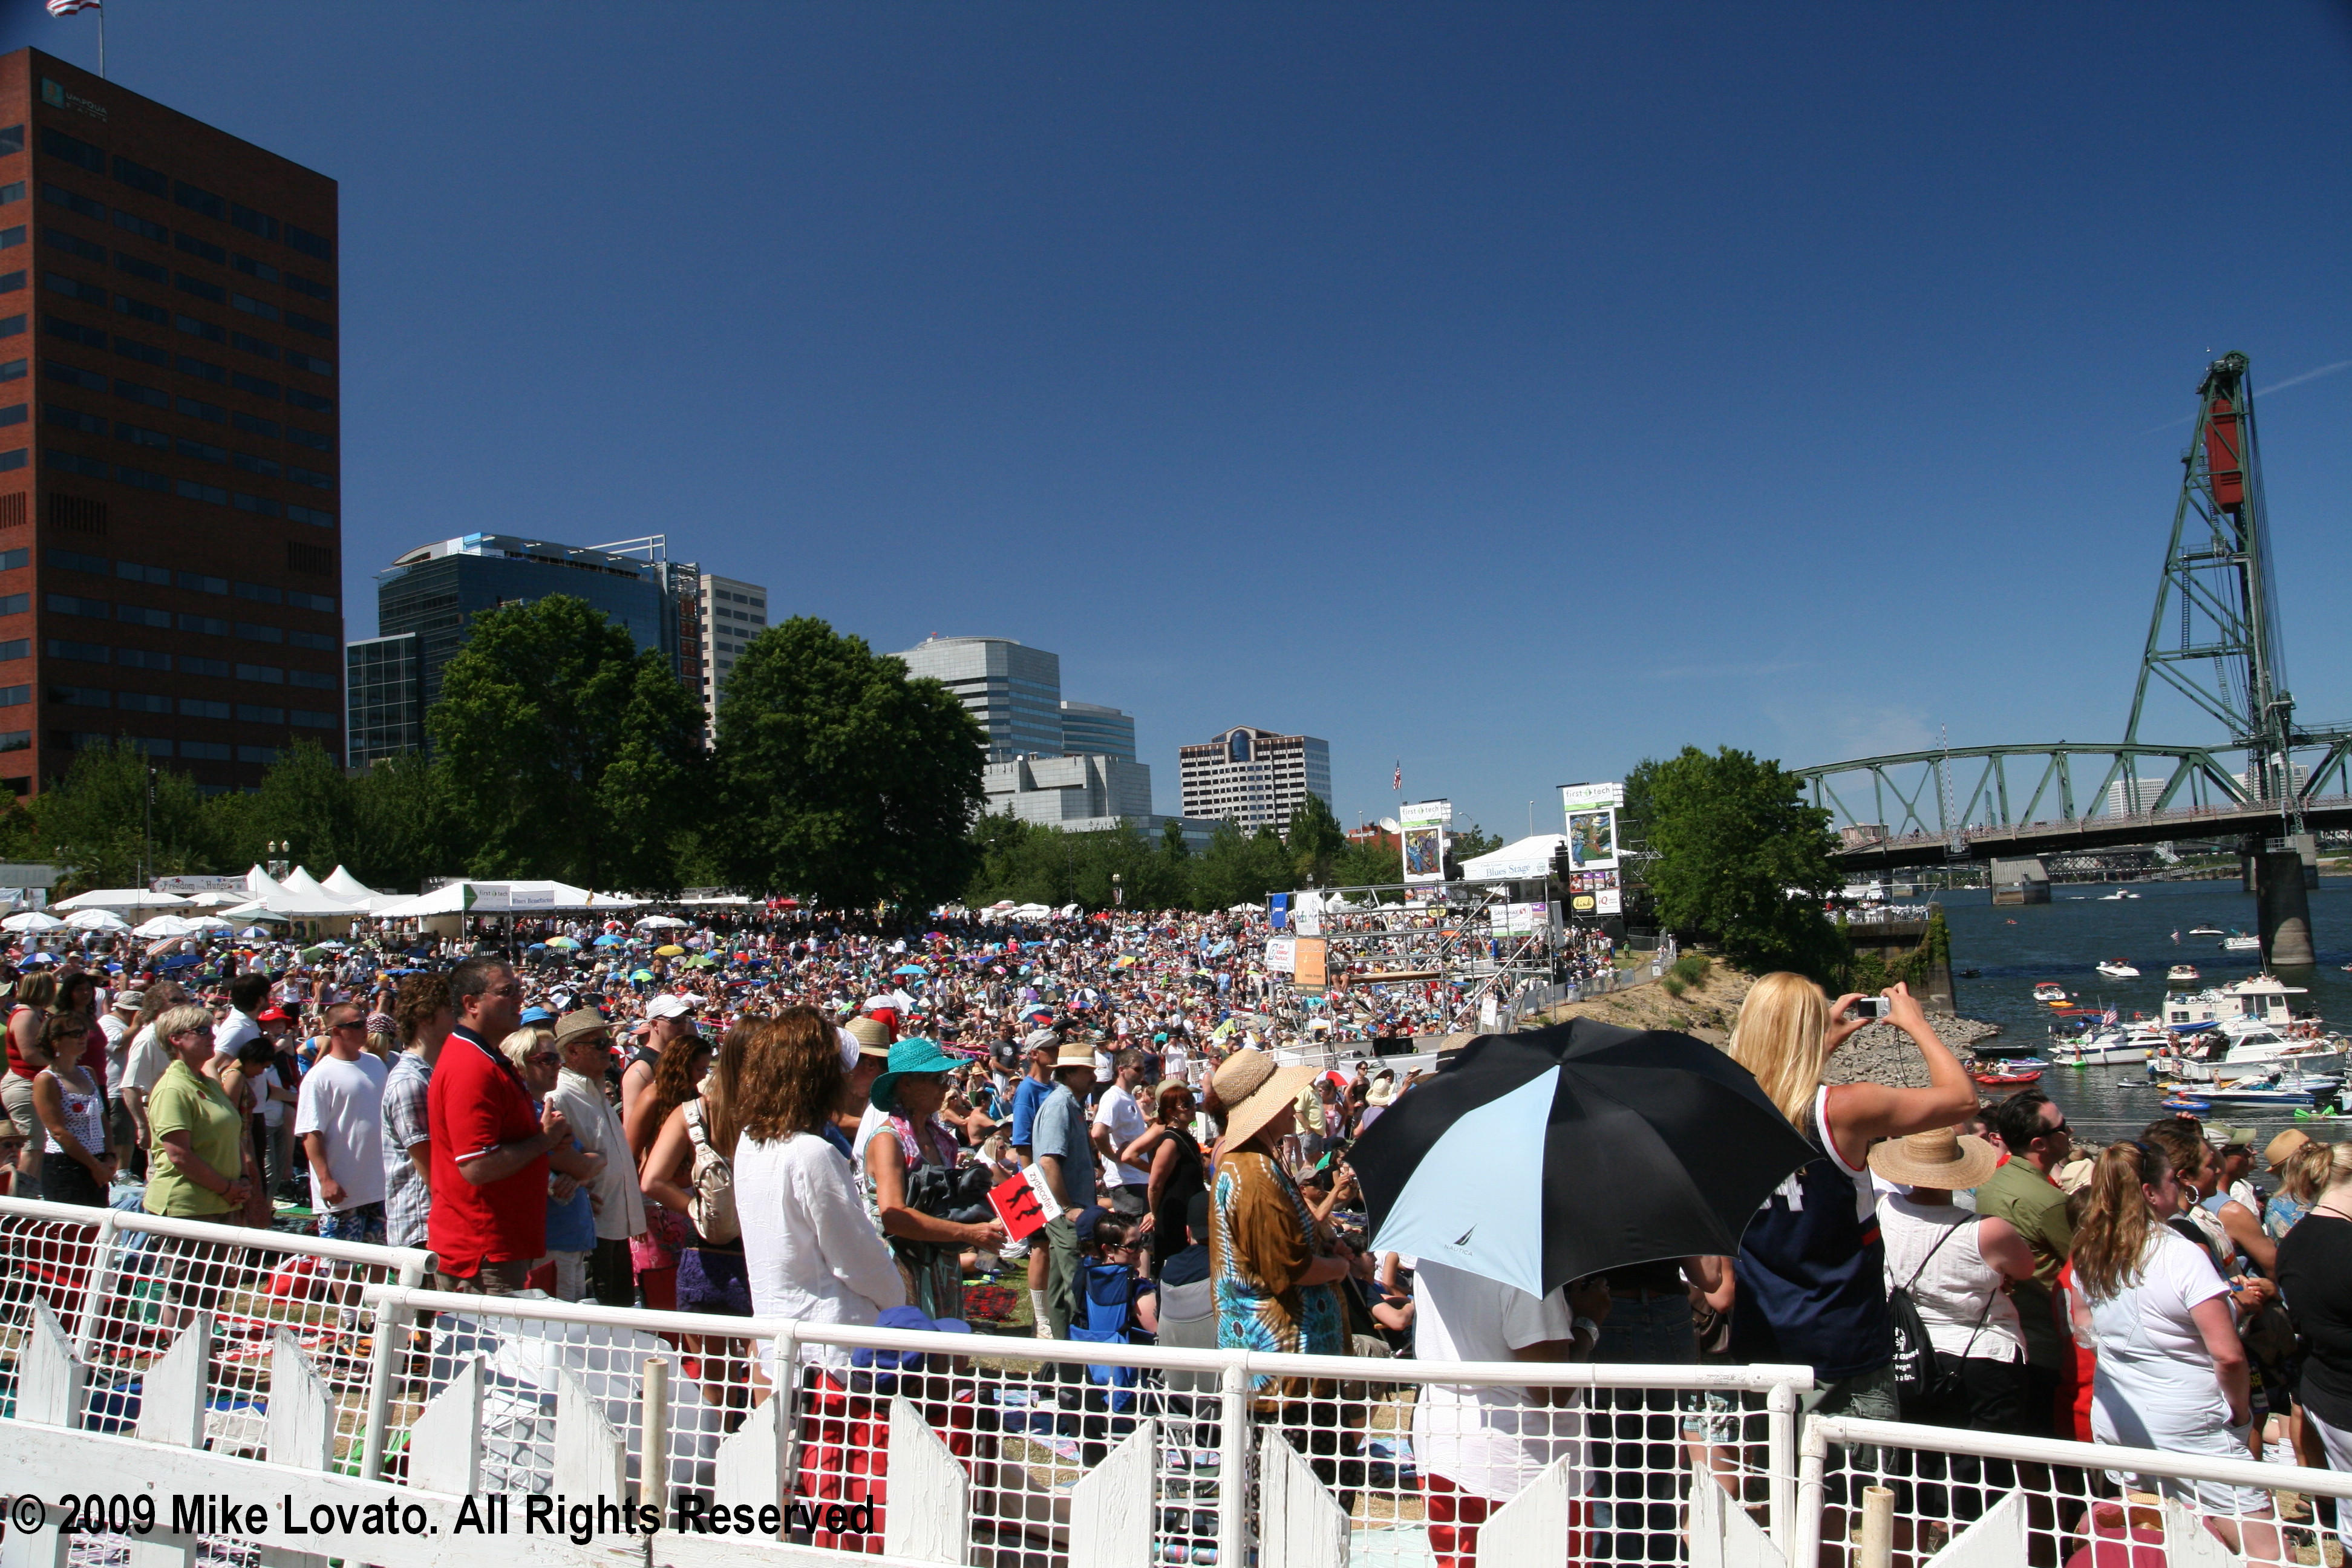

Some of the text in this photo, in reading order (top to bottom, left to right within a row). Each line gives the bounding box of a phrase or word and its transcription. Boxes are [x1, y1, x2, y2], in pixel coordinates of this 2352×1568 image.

[66, 91, 108, 115] UMPQUA
[1593, 786, 1610, 795] tech
[1486, 864, 1530, 877] Blues Stage
[163, 881, 195, 891] Freedom
[1030, 1172, 1054, 1213] zydecofan
[1444, 1244, 1473, 1256] NAUTICA
